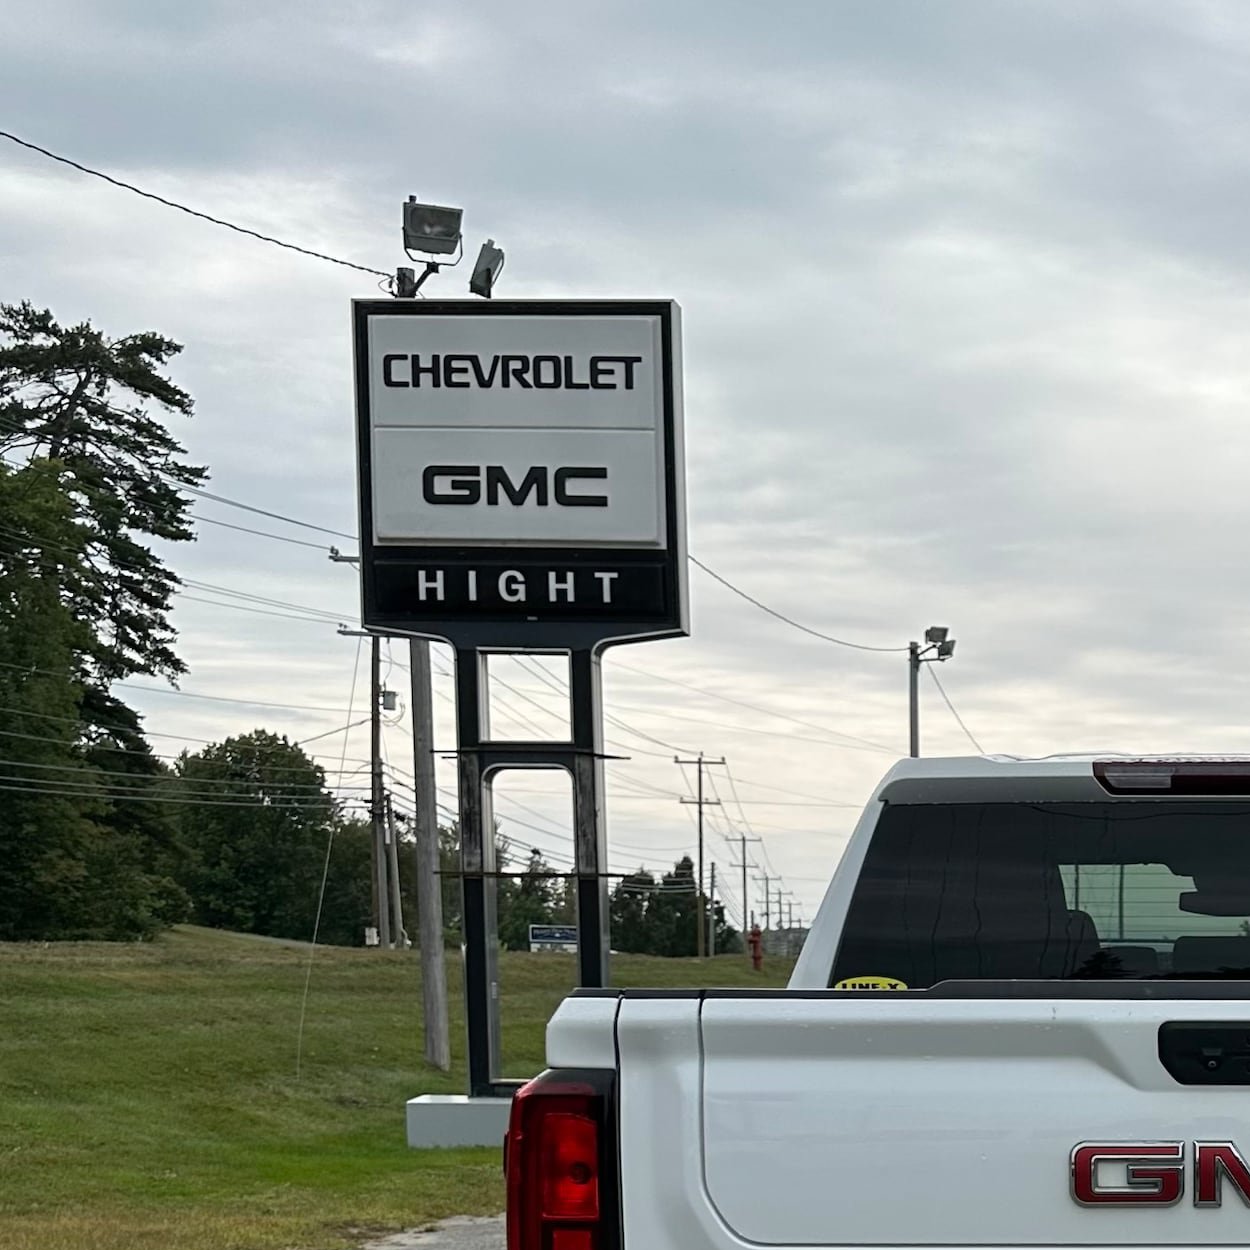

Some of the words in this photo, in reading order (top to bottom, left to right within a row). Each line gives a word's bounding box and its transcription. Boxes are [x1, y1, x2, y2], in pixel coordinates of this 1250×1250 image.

[383, 354, 642, 390] CHEVROLET
[422, 465, 608, 507] GMC
[417, 570, 619, 603] HIGHT
